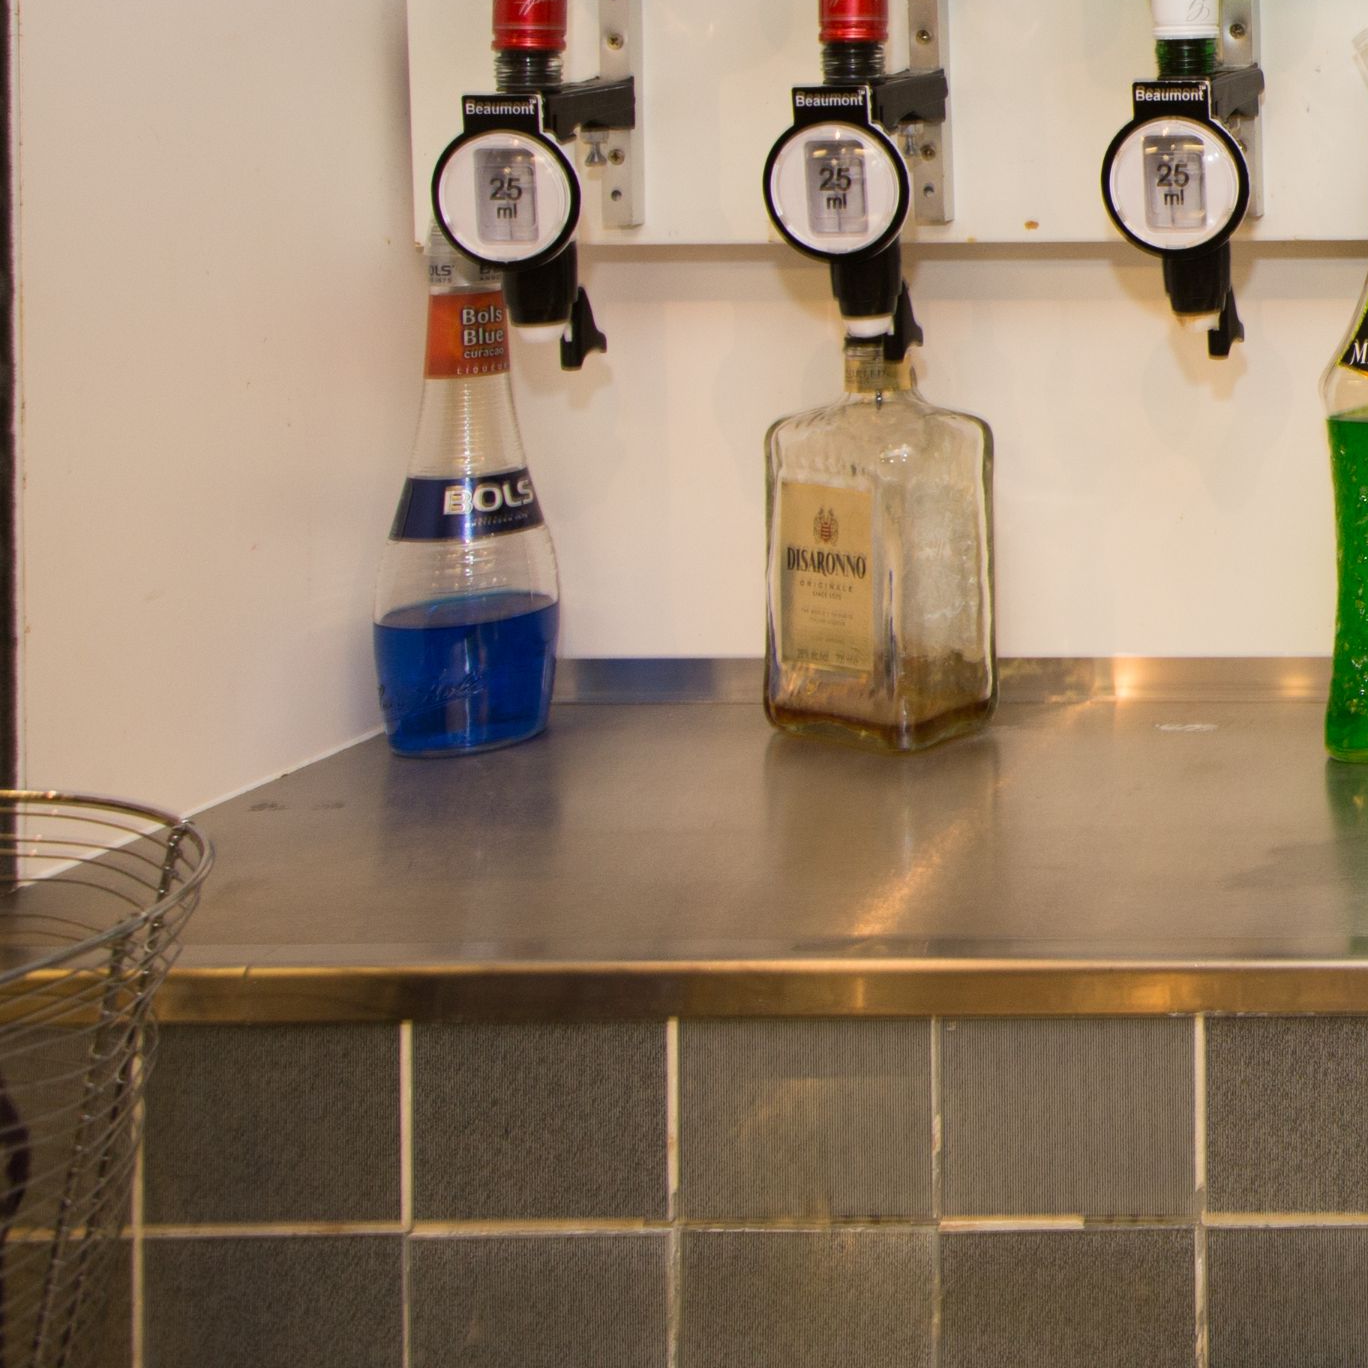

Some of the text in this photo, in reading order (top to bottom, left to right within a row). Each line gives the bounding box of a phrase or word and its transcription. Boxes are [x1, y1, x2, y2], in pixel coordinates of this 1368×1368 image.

[795, 94, 864, 108] Beaumont
[1134, 88, 1204, 102] Beaumont
[465, 102, 536, 116] Beaumont
[818, 167, 852, 192] 25
[1156, 163, 1190, 188] 25
[489, 178, 523, 202] 25
[1163, 189, 1185, 206] ml
[826, 193, 848, 210] ml
[496, 204, 518, 220] ml
[461, 305, 503, 325] Bols
[462, 329, 504, 347] Blue
[443, 480, 534, 516] BOLS
[786, 546, 867, 580] DISARONNO
